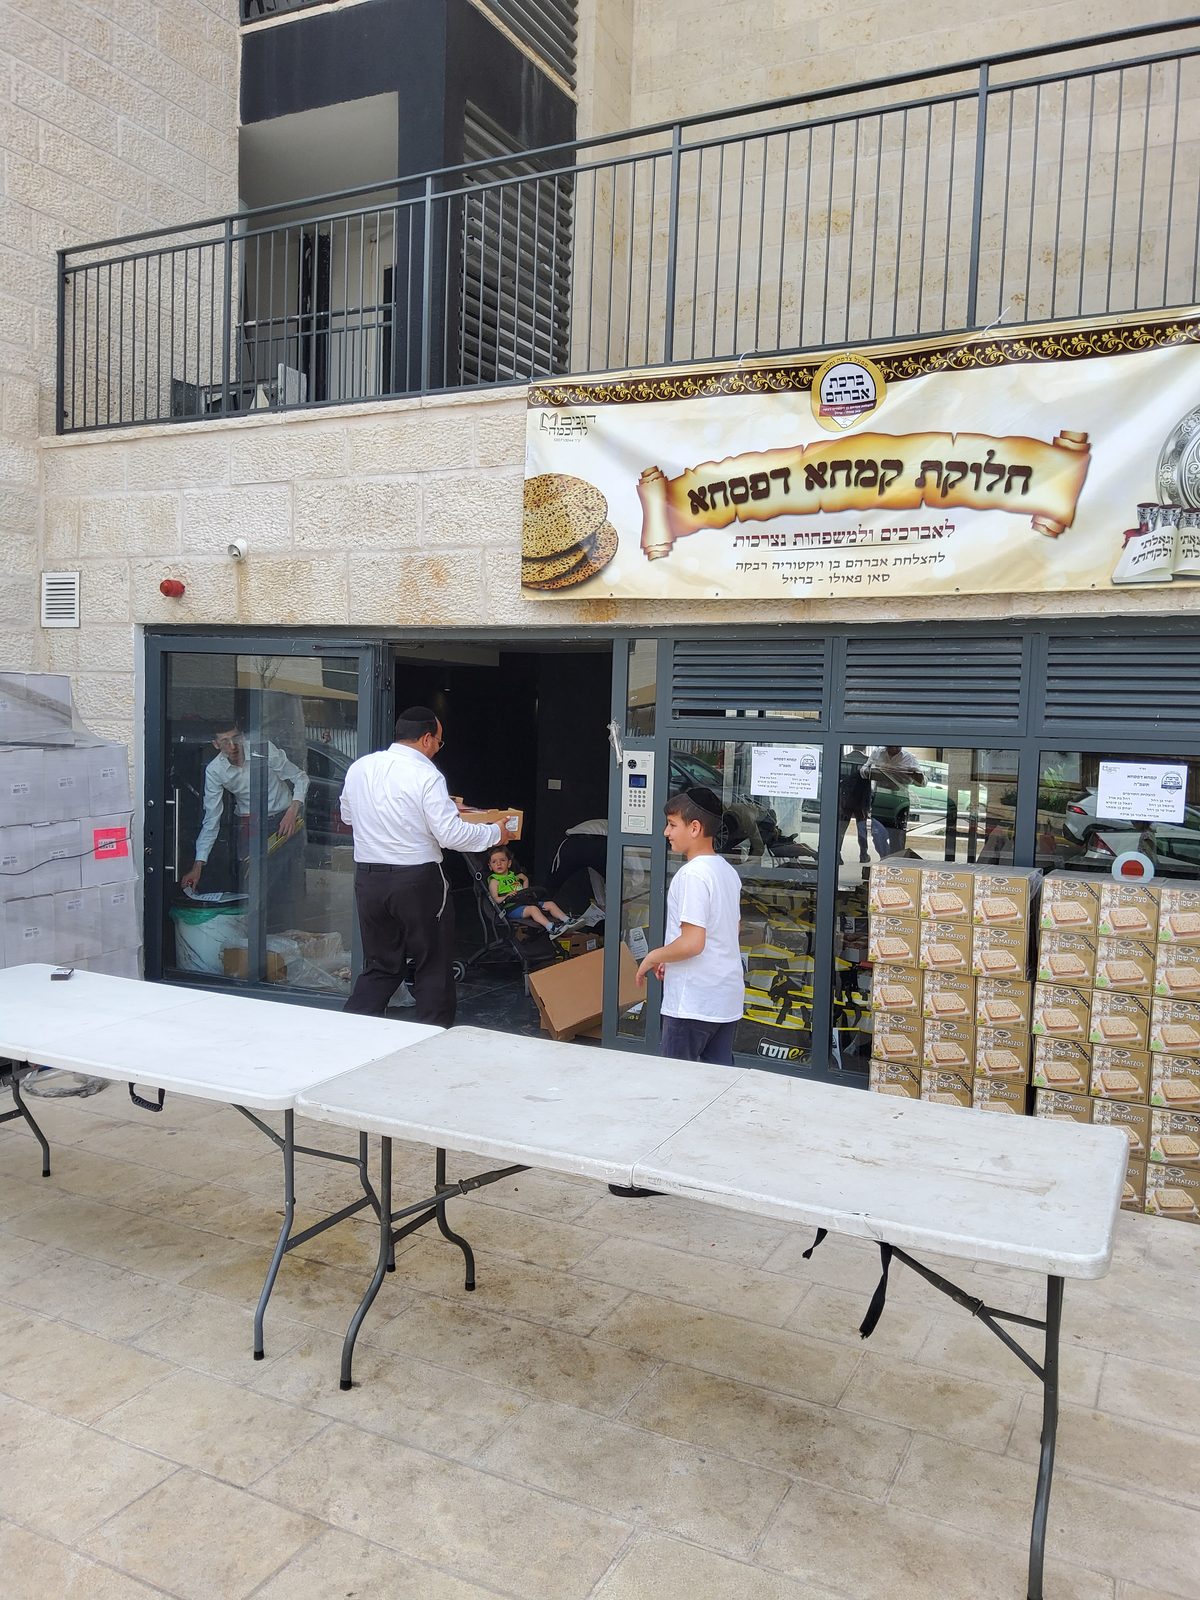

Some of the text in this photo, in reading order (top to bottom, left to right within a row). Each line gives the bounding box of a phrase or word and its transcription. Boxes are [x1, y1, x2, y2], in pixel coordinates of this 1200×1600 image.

[829, 375, 864, 388] ברכת
[826, 388, 870, 402] אברהם
[687, 449, 1033, 514] חלוקת קמחא דפסחא
[733, 519, 955, 547] לאברכים ולמשפחות נצרכות
[1141, 535, 1173, 549] וגאלתי
[1132, 544, 1172, 565] ולקחתי
[736, 552, 946, 572] להצלחת אברהם בן ויקטוריה רבקה
[782, 573, 813, 585] ברזיל
[829, 573, 862, 584] פאולו
[868, 573, 890, 585] סאן
[760, 1043, 789, 1059] חסד
